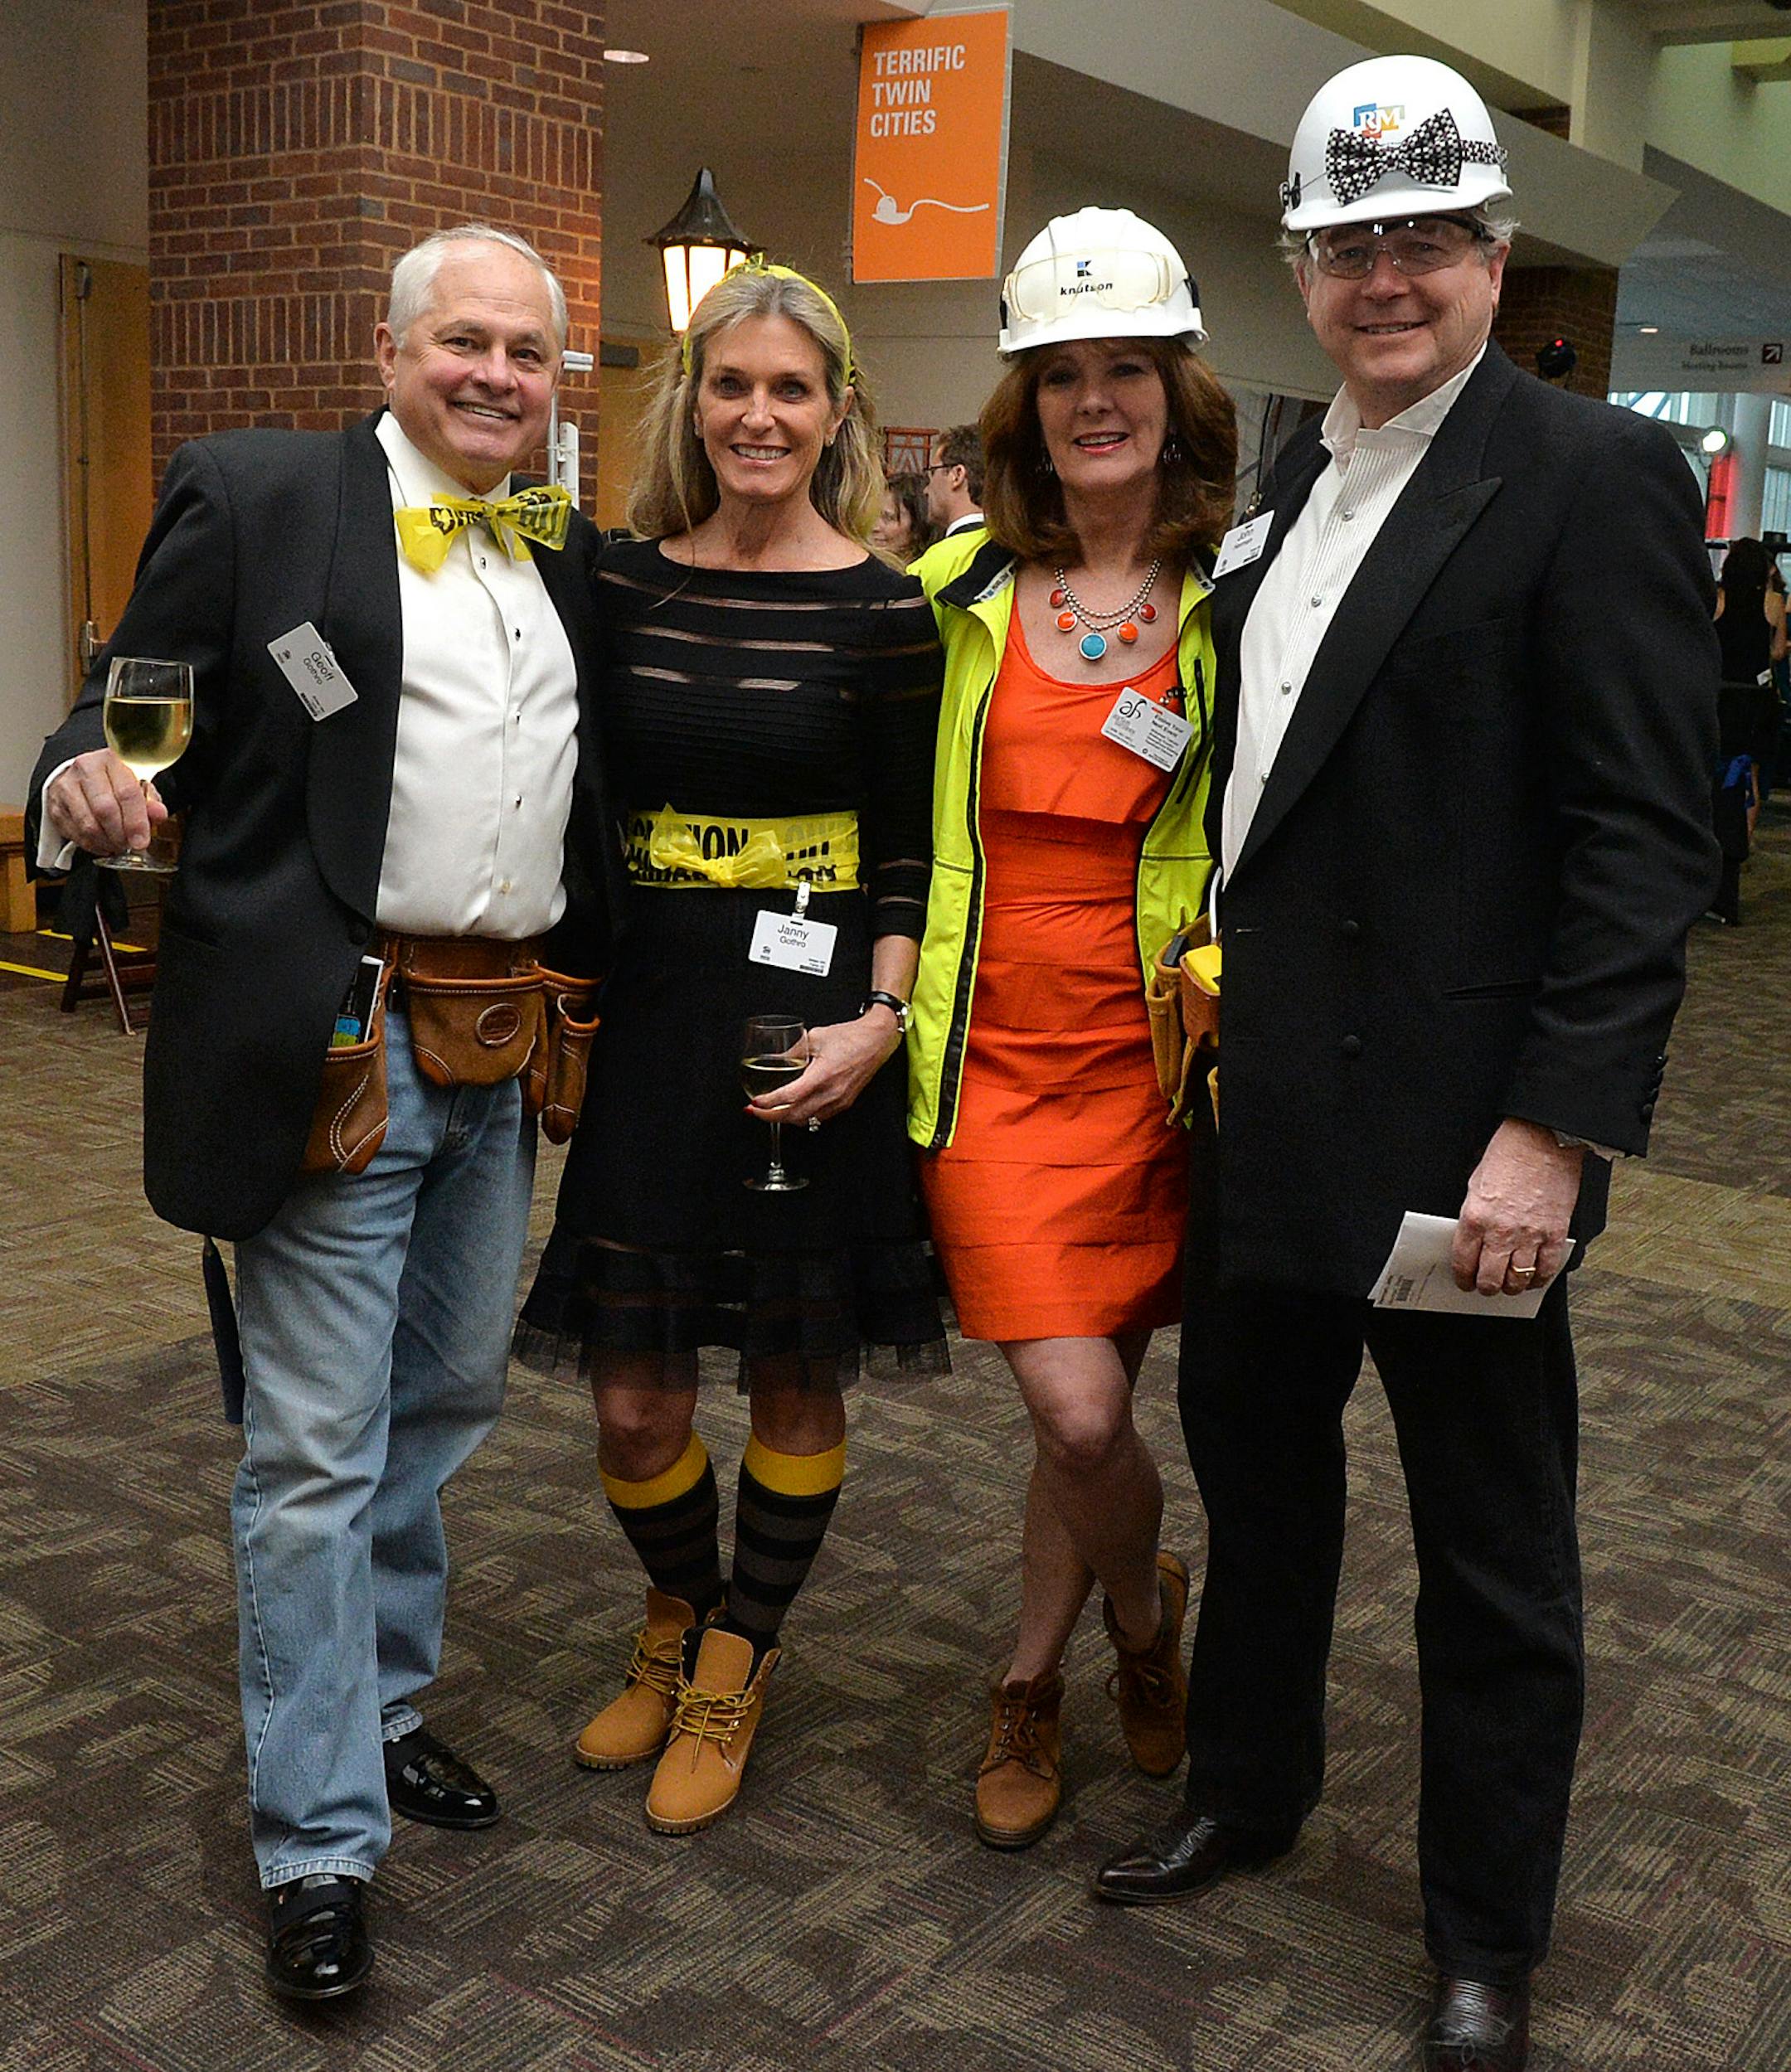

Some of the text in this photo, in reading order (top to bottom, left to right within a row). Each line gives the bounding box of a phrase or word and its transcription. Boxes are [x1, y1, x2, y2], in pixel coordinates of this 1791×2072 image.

[874, 44, 965, 75] TERRIFIC
[872, 79, 931, 107] TWIN
[871, 109, 936, 137] CITIES
[1060, 282, 1113, 296] knutson
[311, 652, 334, 681] Geoff
[777, 924, 809, 940] Janny
[779, 936, 806, 949] Gothro
